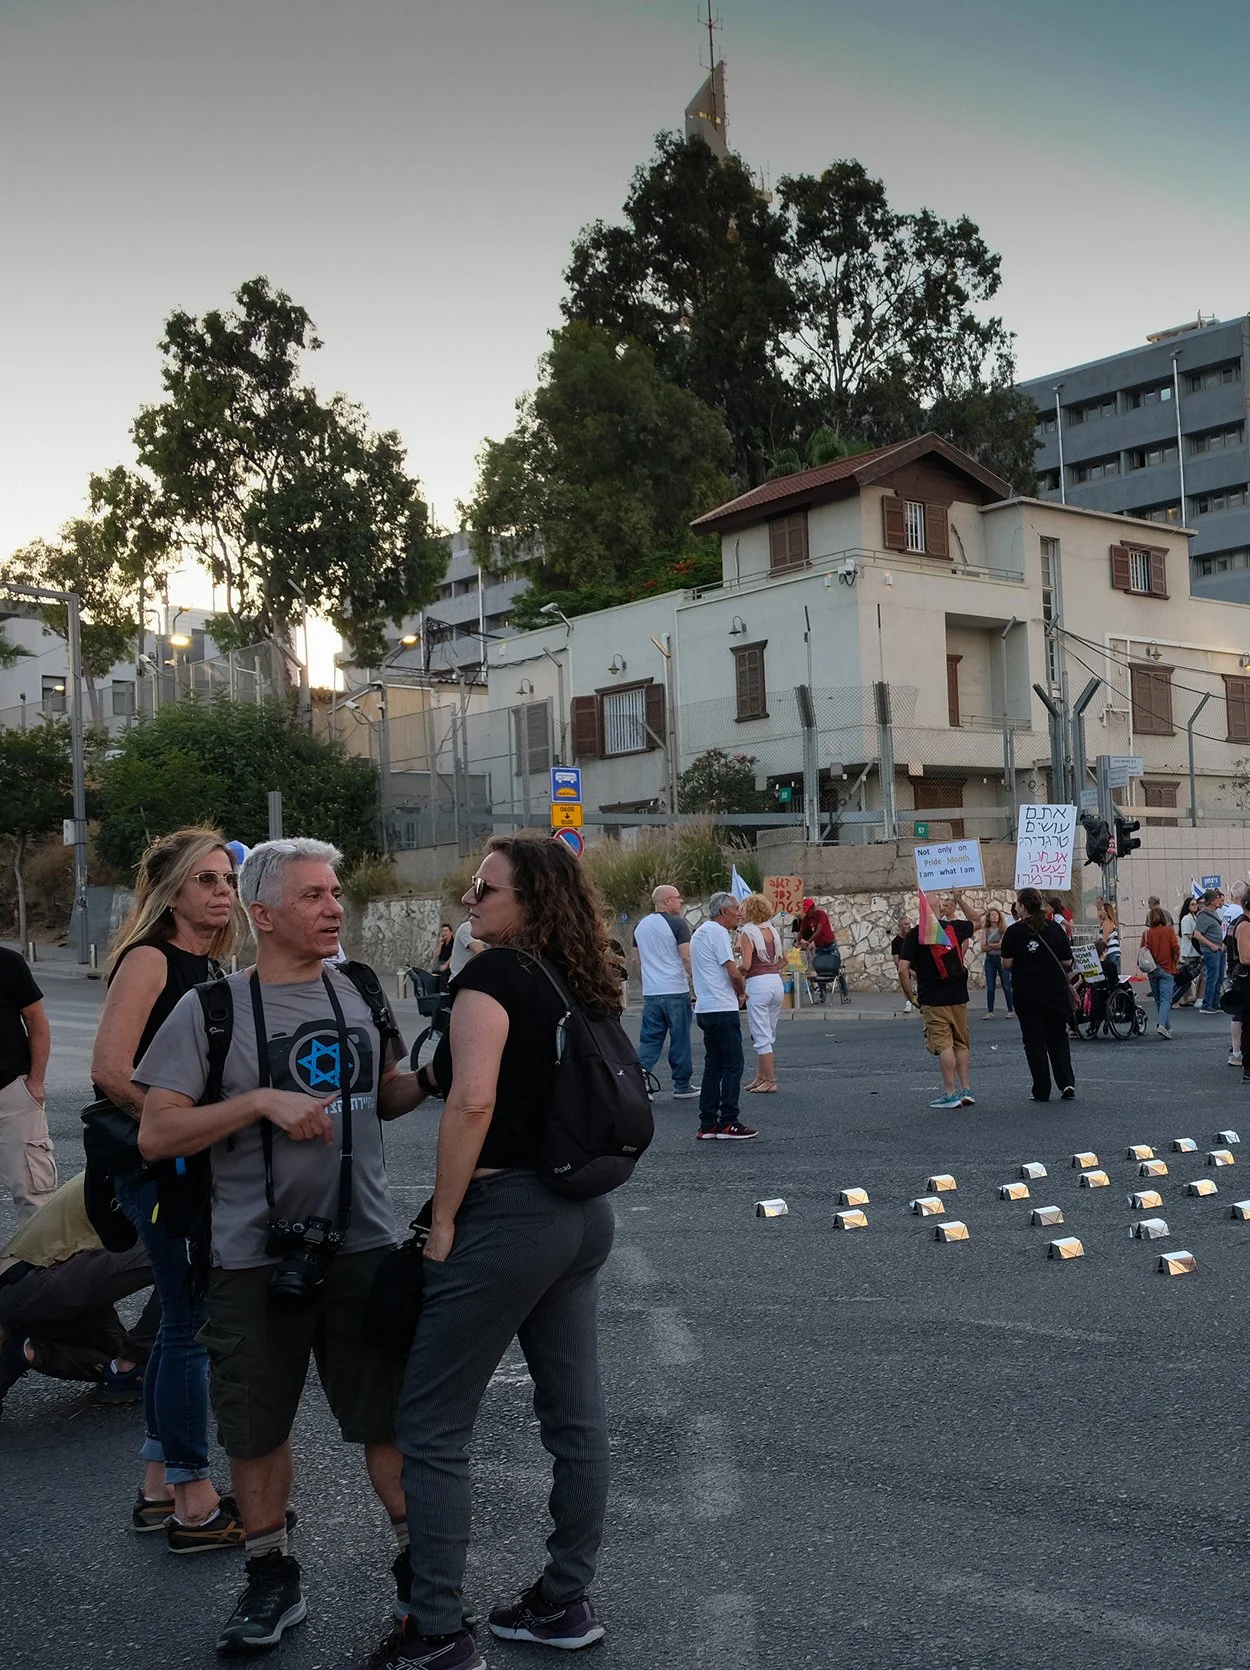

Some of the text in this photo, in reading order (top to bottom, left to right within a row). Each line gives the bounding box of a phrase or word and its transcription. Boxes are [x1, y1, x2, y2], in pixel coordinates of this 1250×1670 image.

[1025, 806, 1067, 819] אתם
[1025, 820, 1071, 834] עושים
[917, 848, 930, 856] Not
[937, 845, 952, 854] only
[924, 855, 970, 867] Pride Month
[1028, 851, 1069, 864] אנחנו
[939, 867, 957, 876] what
[1030, 864, 1068, 875] נעשה
[1083, 962, 1099, 970] HELL
[553, 1163, 572, 1175] Road
